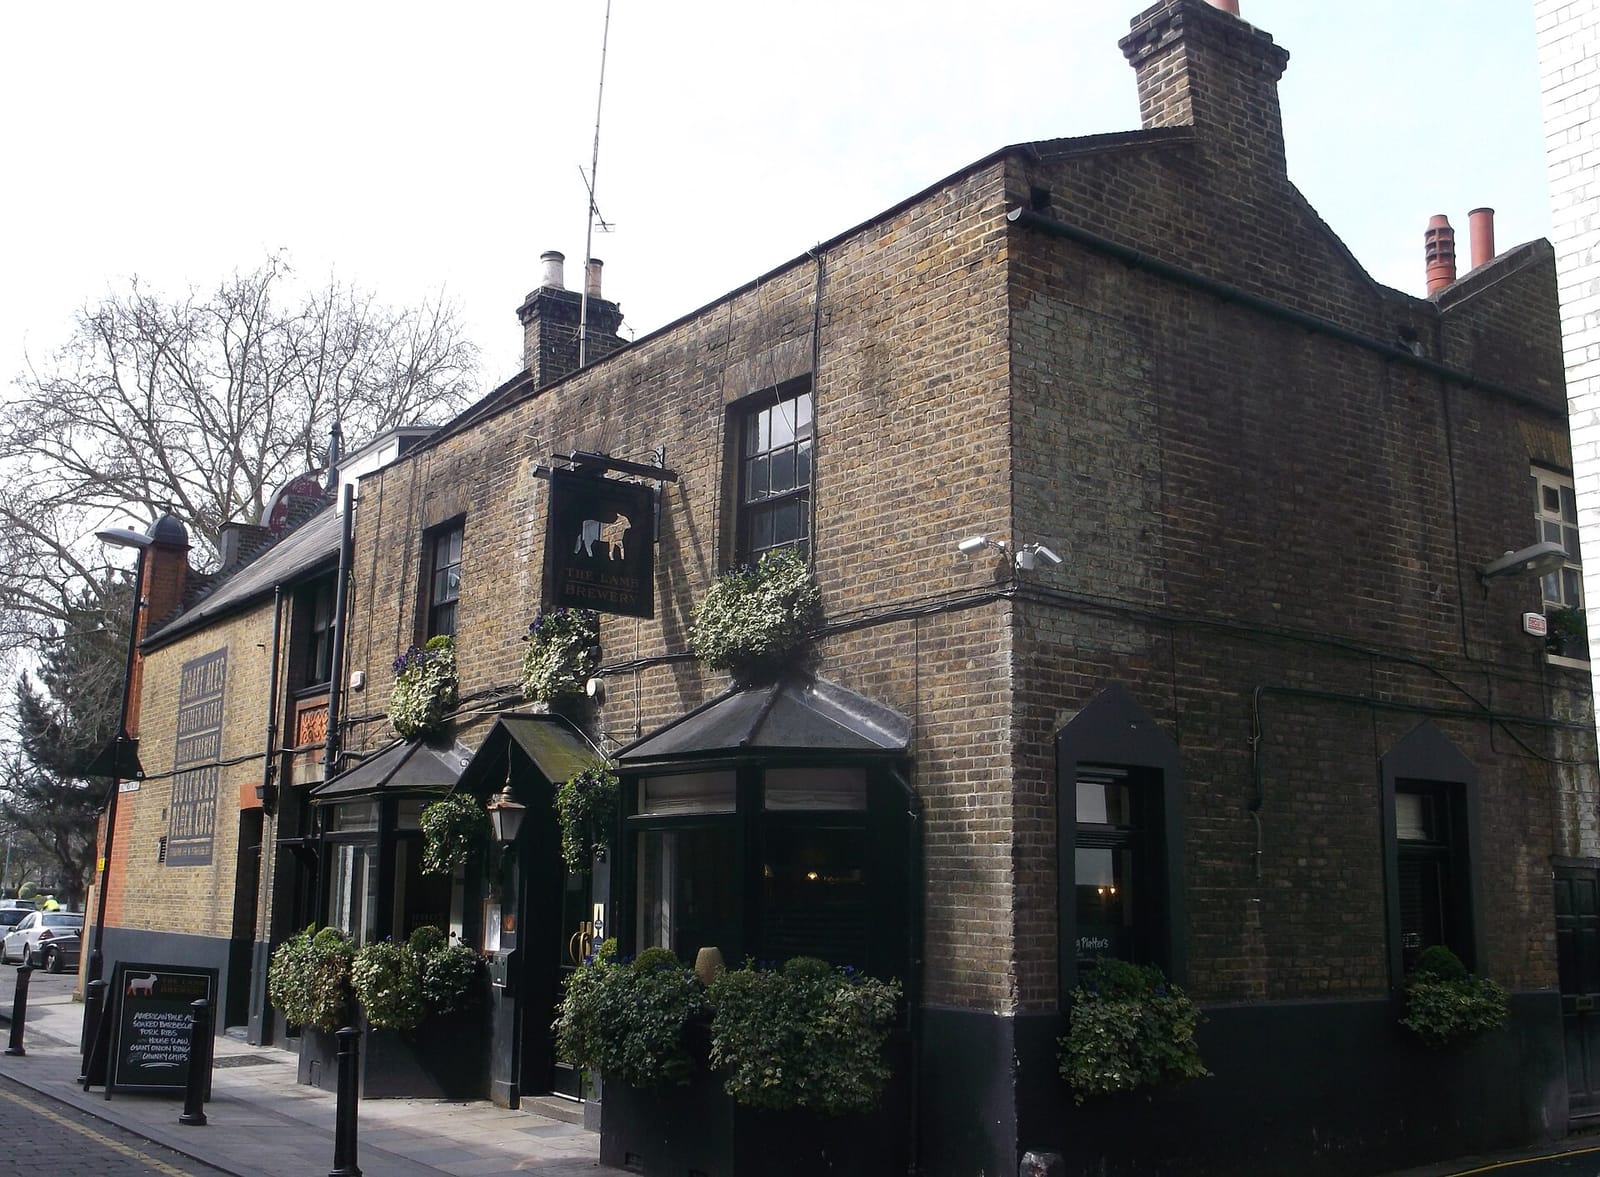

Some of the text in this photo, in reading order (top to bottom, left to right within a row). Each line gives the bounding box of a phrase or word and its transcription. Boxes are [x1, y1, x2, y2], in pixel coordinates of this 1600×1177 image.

[565, 567, 640, 589] THE LAMB
[565, 583, 638, 604] BREWERY
[205, 657, 225, 694] ALES
[194, 800, 214, 836] CUTS
[133, 1012, 167, 1020] AMERICAN
[168, 1013, 183, 1021] PALE
[133, 1020, 159, 1028] SOAKED
[140, 1028, 178, 1037] PORK RIBS
[142, 1052, 168, 1061] CHUNKY
[167, 1053, 188, 1062] CHIPS
